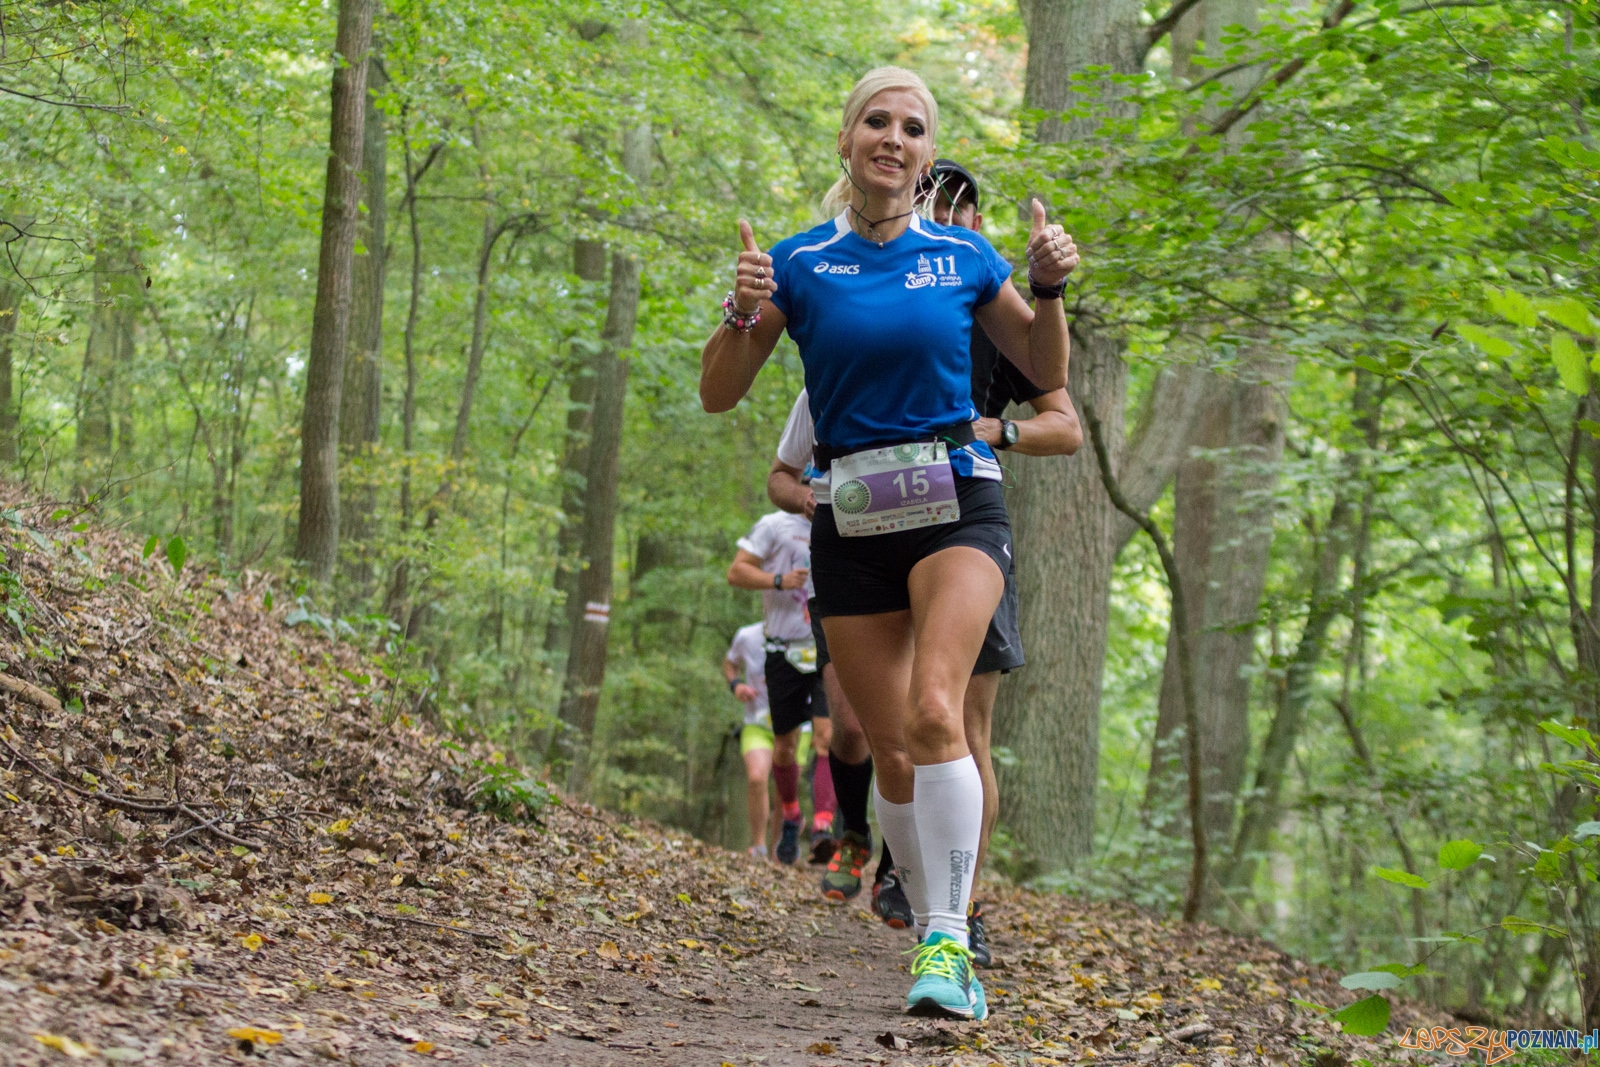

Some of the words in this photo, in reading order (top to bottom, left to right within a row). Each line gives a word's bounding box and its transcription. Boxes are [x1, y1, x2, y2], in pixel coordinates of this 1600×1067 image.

[828, 264, 860, 275] asics
[933, 255, 957, 275] 11
[911, 276, 931, 286] LOTTO
[893, 469, 930, 498] 15
[949, 849, 963, 913] COMPRESSION
